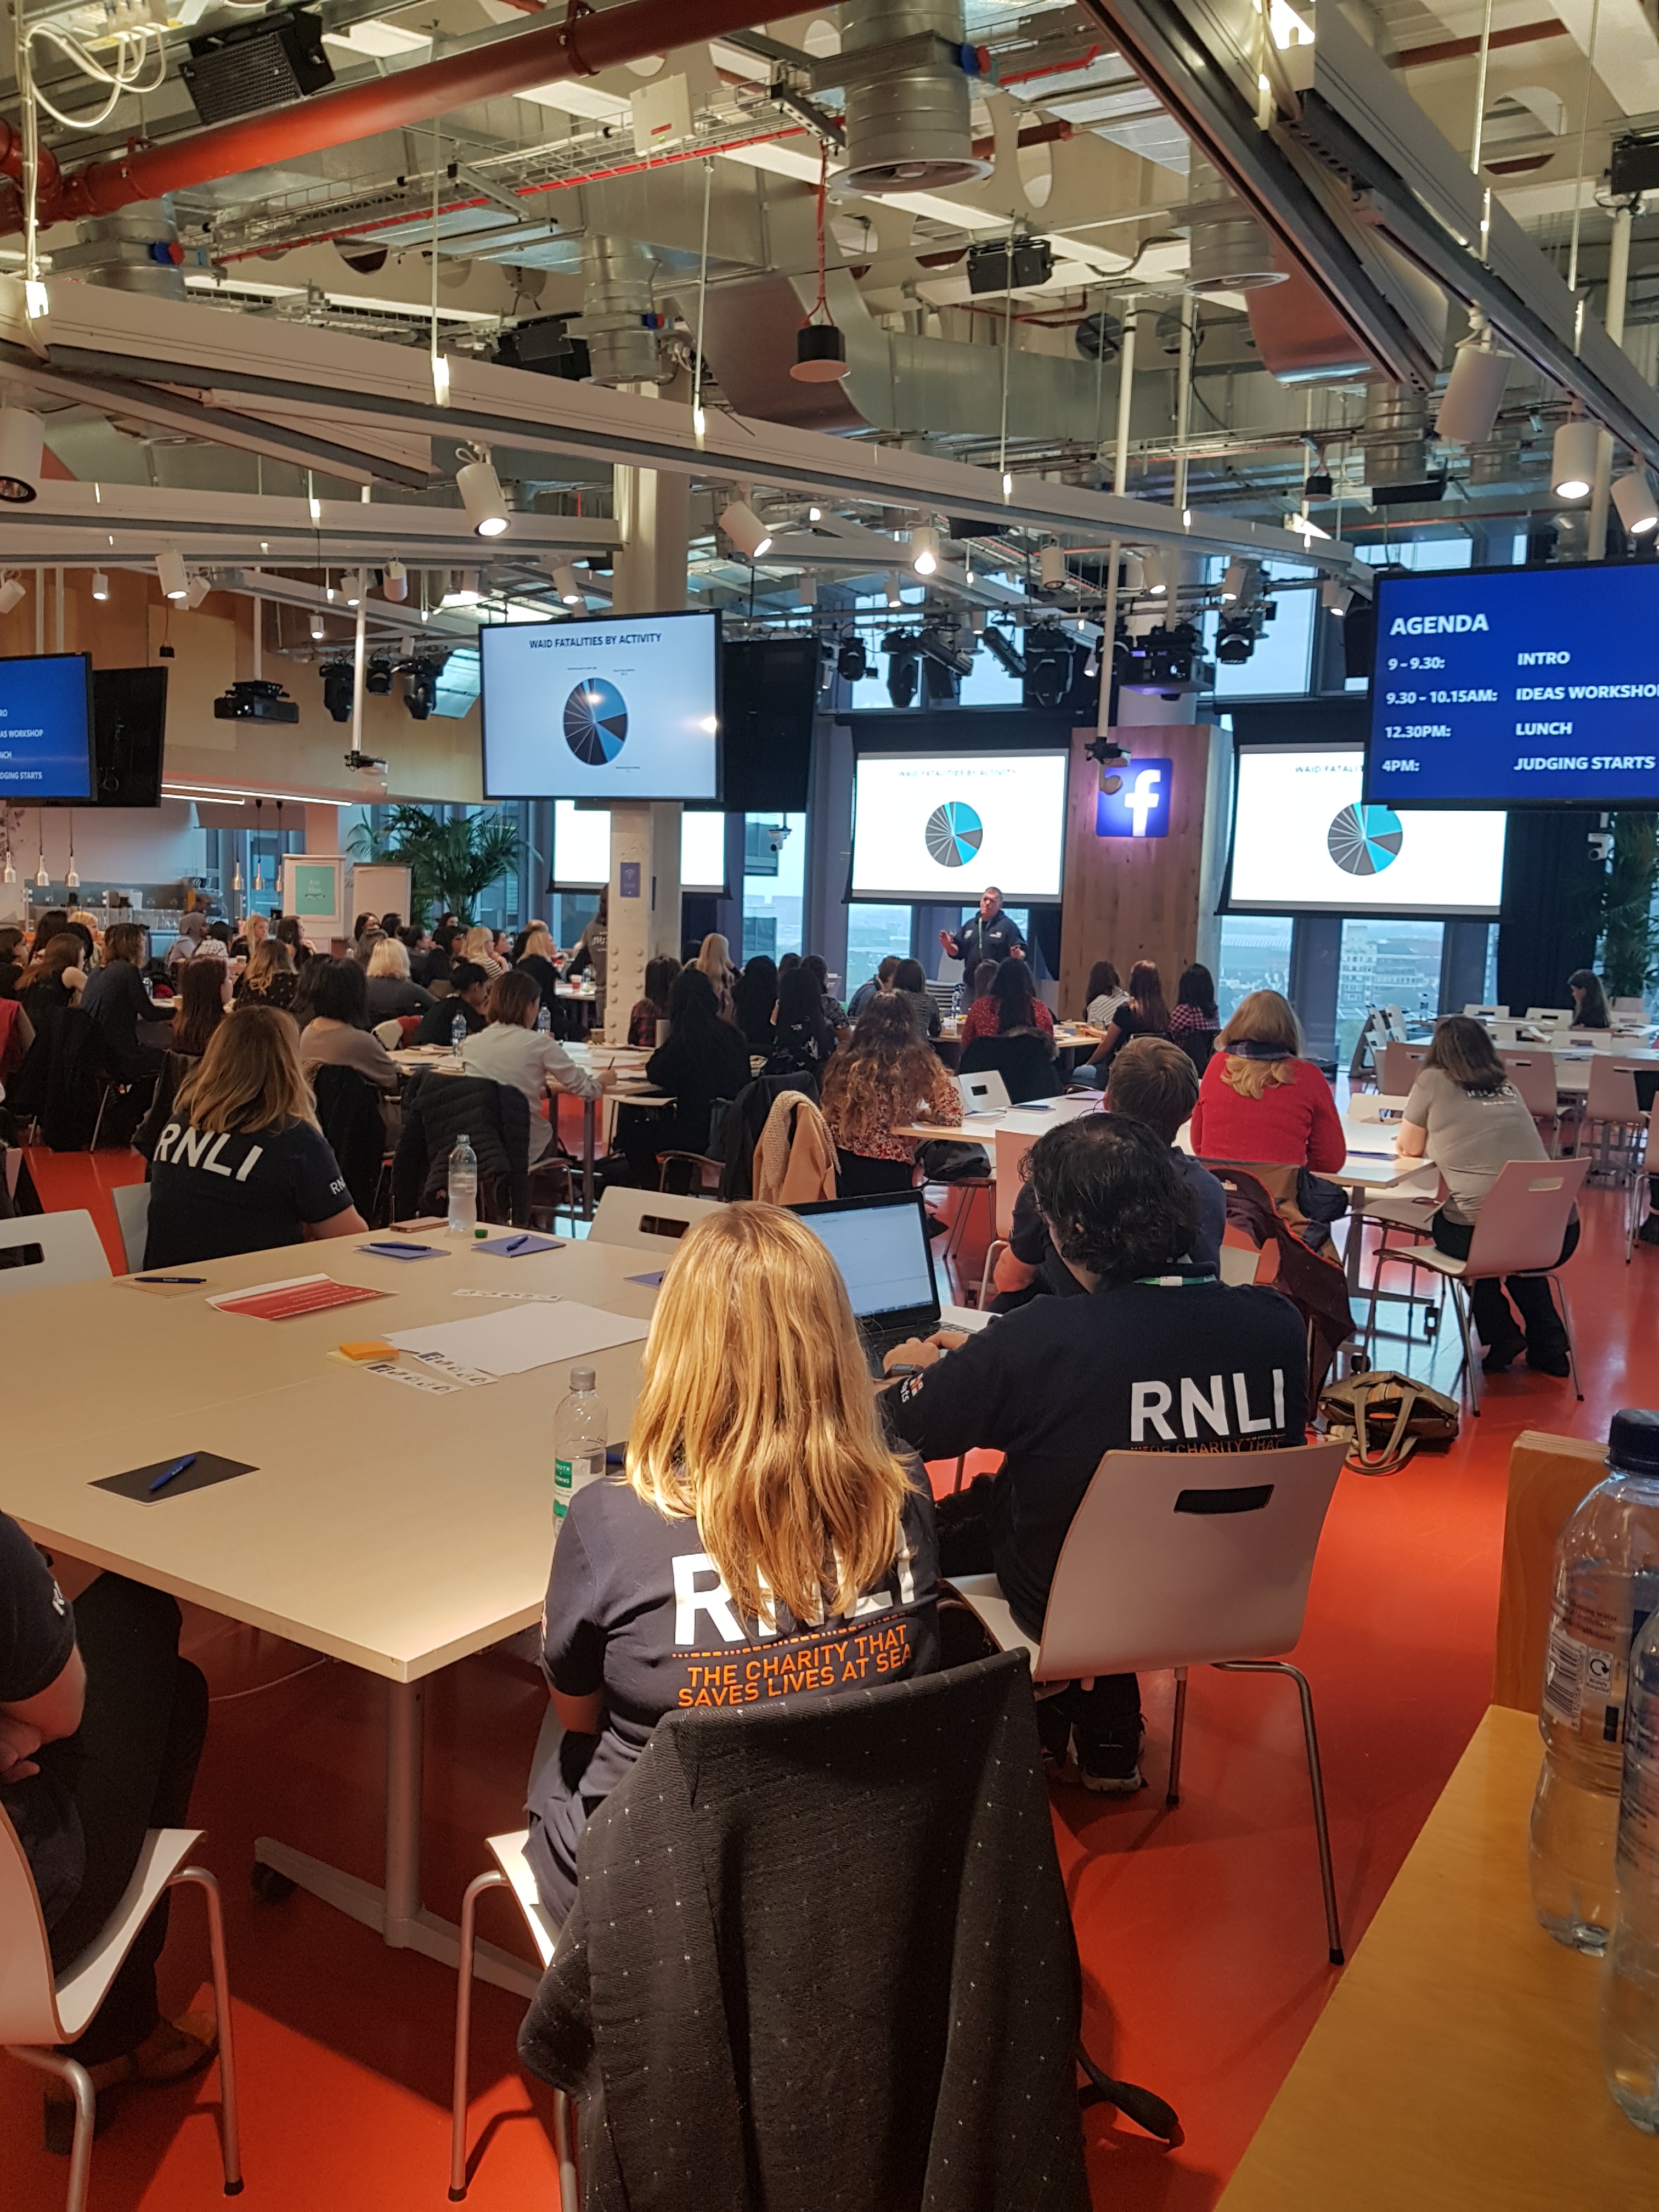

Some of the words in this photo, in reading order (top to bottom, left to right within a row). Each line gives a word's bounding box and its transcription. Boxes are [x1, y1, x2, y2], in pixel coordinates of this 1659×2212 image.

[1390, 614, 1489, 635] AGENDA
[555, 636, 603, 647] FATALITIES
[606, 636, 617, 645] BY
[619, 633, 662, 644] ACTIVITY
[1388, 658, 1398, 670] 9
[1410, 657, 1446, 669] 9.30:
[1517, 652, 1571, 665] INTRO
[1386, 692, 1417, 704] 9.30
[1430, 689, 1498, 703] 10.15AM:
[1516, 687, 1565, 701] IDEAS
[8, 729, 43, 738] WORKSHOP
[1385, 725, 1452, 738] 12.30PM:
[1515, 722, 1573, 736] LUNCH
[1382, 760, 1420, 772] 4PM:
[1514, 757, 1588, 770] JUDGING
[1591, 756, 1656, 769] STARTS
[20, 771, 42, 780] STARTS
[154, 1124, 263, 1181] RNLI
[1131, 1369, 1285, 1442] RNLI
[687, 1664, 737, 1688] THE
[746, 1641, 848, 1680] CHARITY
[855, 1624, 907, 1655] THAT
[678, 1681, 759, 1707] SAVES
[768, 1668, 834, 1697] LIVES
[842, 1657, 868, 1682] AT
[876, 1643, 911, 1673] SEA
